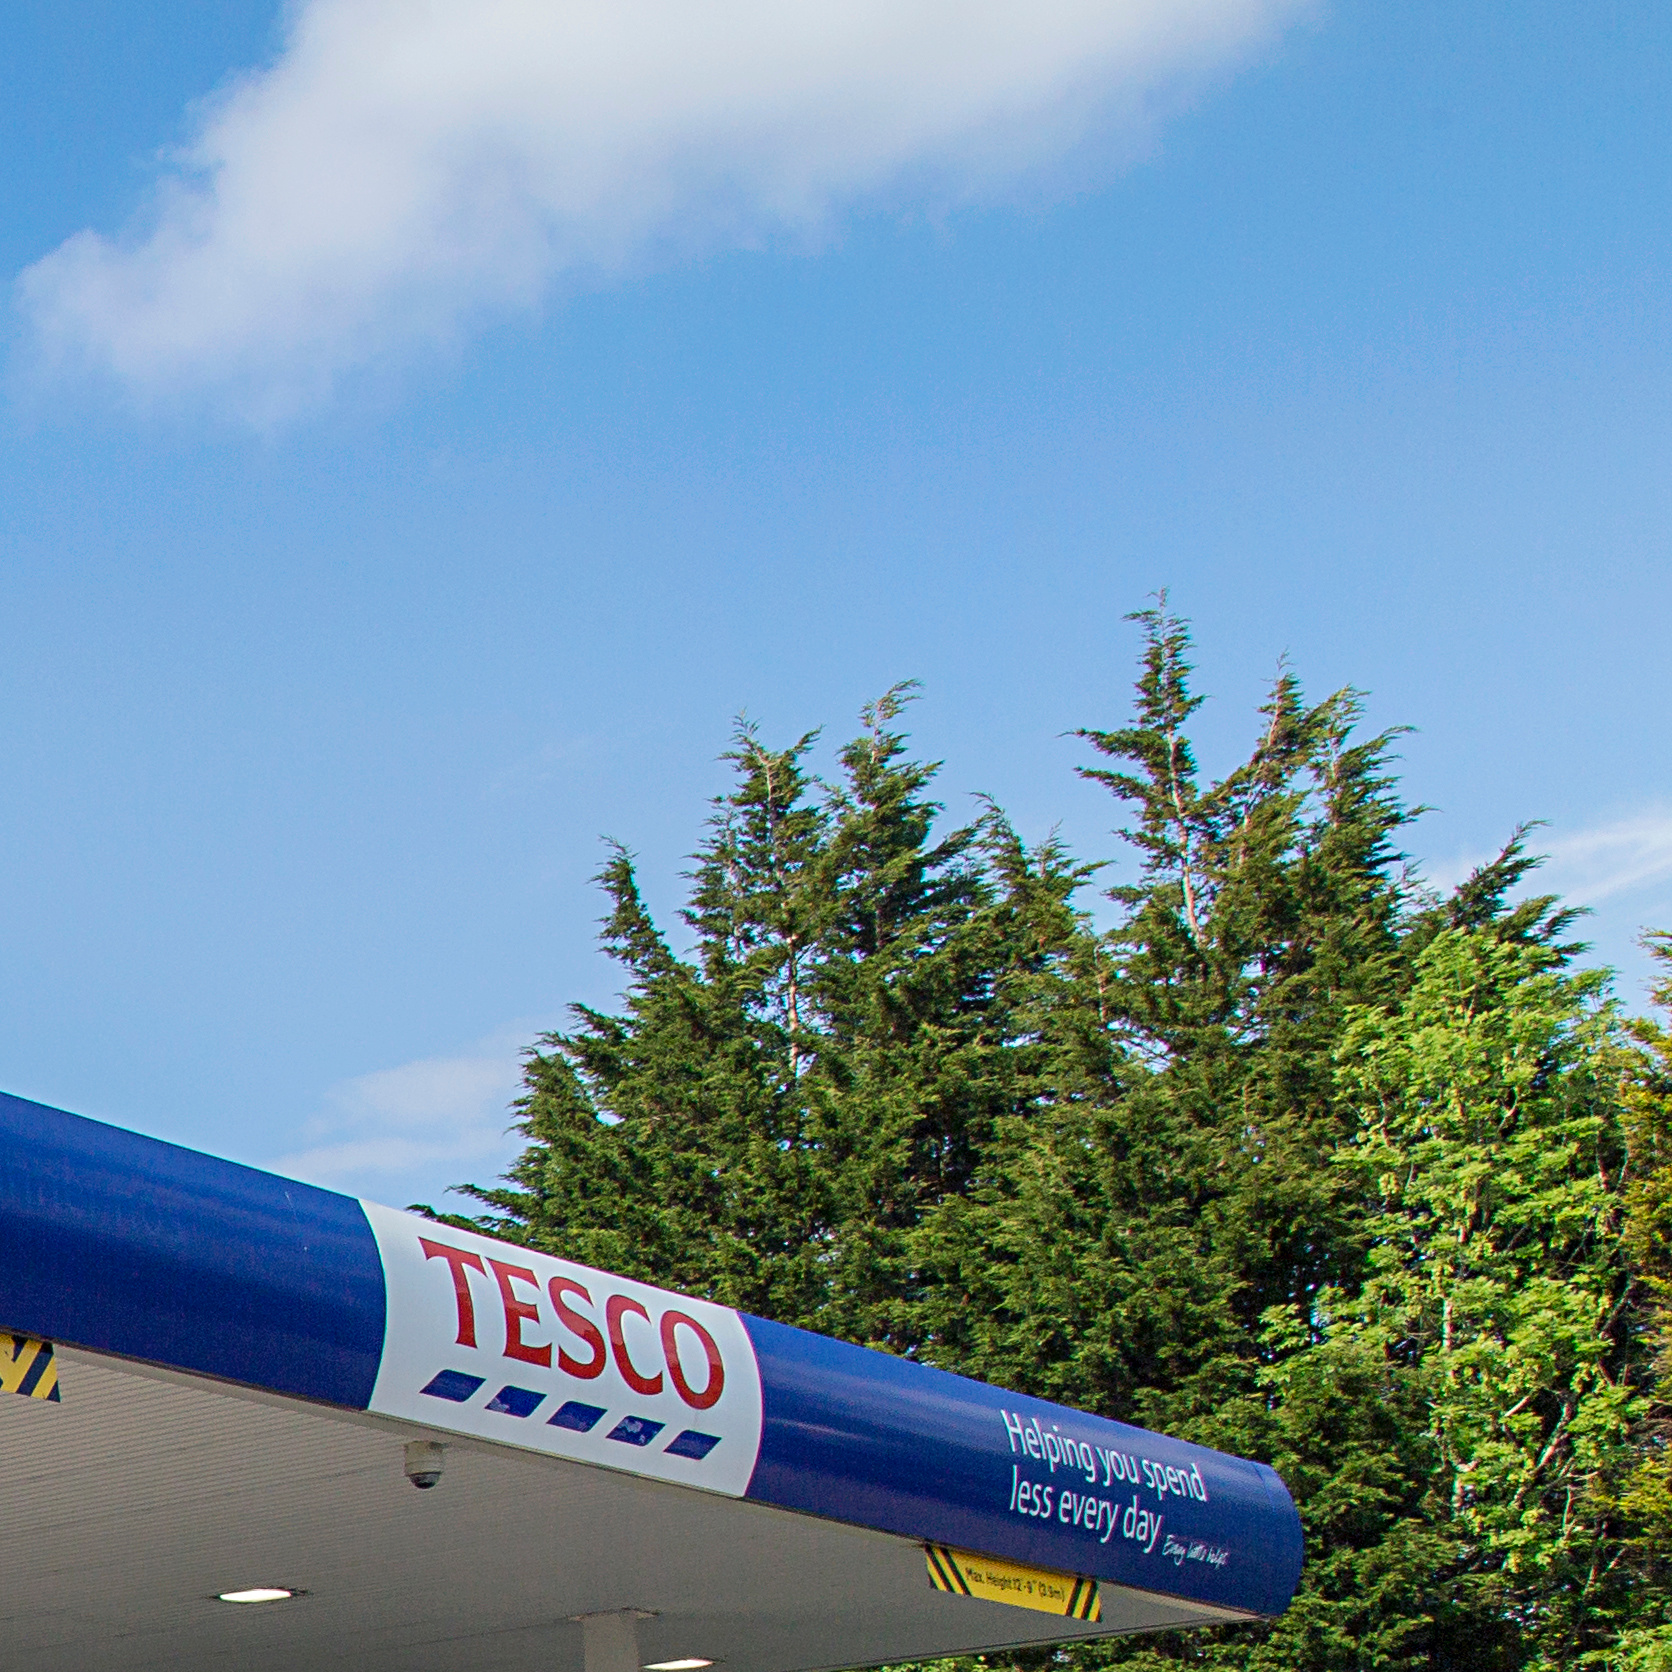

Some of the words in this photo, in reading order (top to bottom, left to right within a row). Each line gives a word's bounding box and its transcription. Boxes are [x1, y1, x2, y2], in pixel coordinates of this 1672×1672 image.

[418, 1236, 725, 1410] TESCO
[1001, 1409, 1096, 1482] Helping
[1095, 1446, 1139, 1487] you
[1142, 1459, 1209, 1502] spend
[1010, 1464, 1054, 1518] less
[1058, 1489, 1119, 1543] every
[1123, 1495, 1164, 1554] day
